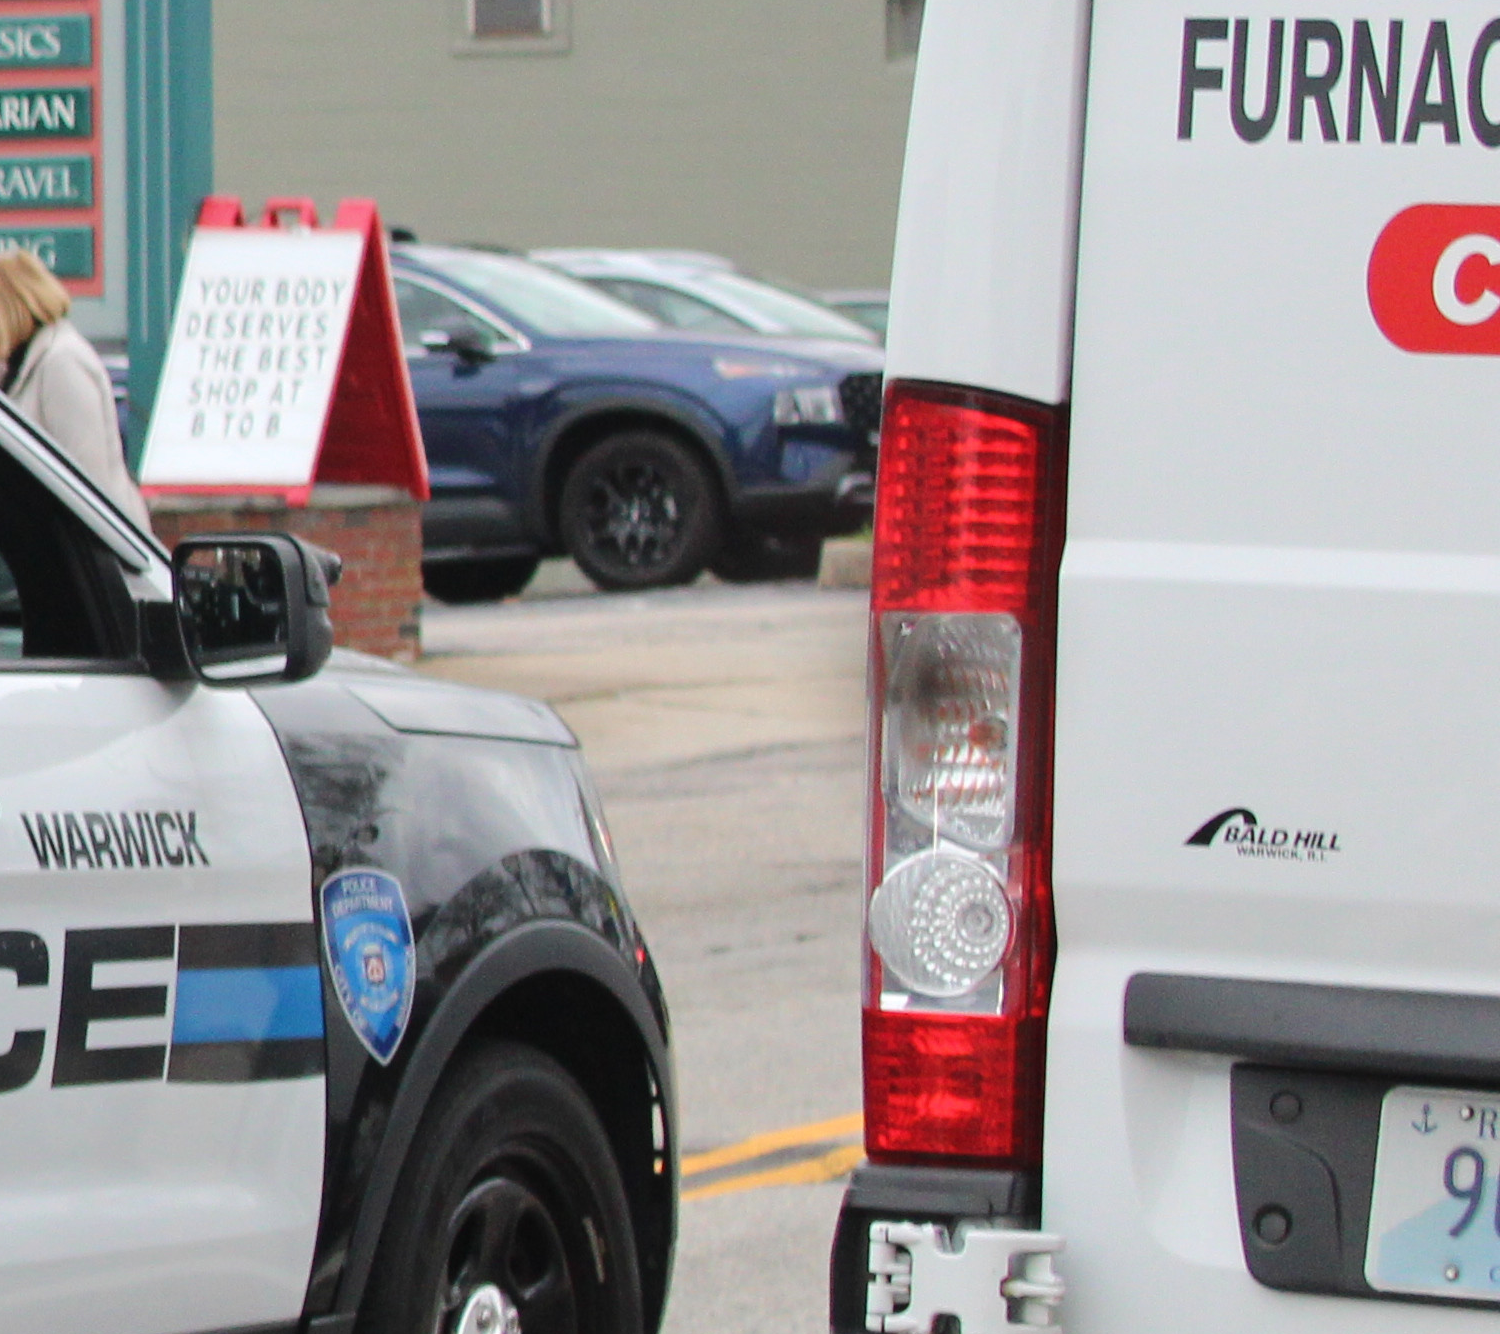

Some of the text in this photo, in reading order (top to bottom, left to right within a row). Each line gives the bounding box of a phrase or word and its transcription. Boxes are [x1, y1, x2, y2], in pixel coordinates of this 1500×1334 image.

[199, 276, 347, 306] YOUR BODY
[186, 311, 329, 339] DESERVES
[198, 345, 327, 372] THE BEST
[189, 379, 303, 405] SHOP AT
[191, 413, 281, 439] B TO B
[20, 811, 209, 869] WARWICK
[1224, 825, 1341, 851] BALD HILL
